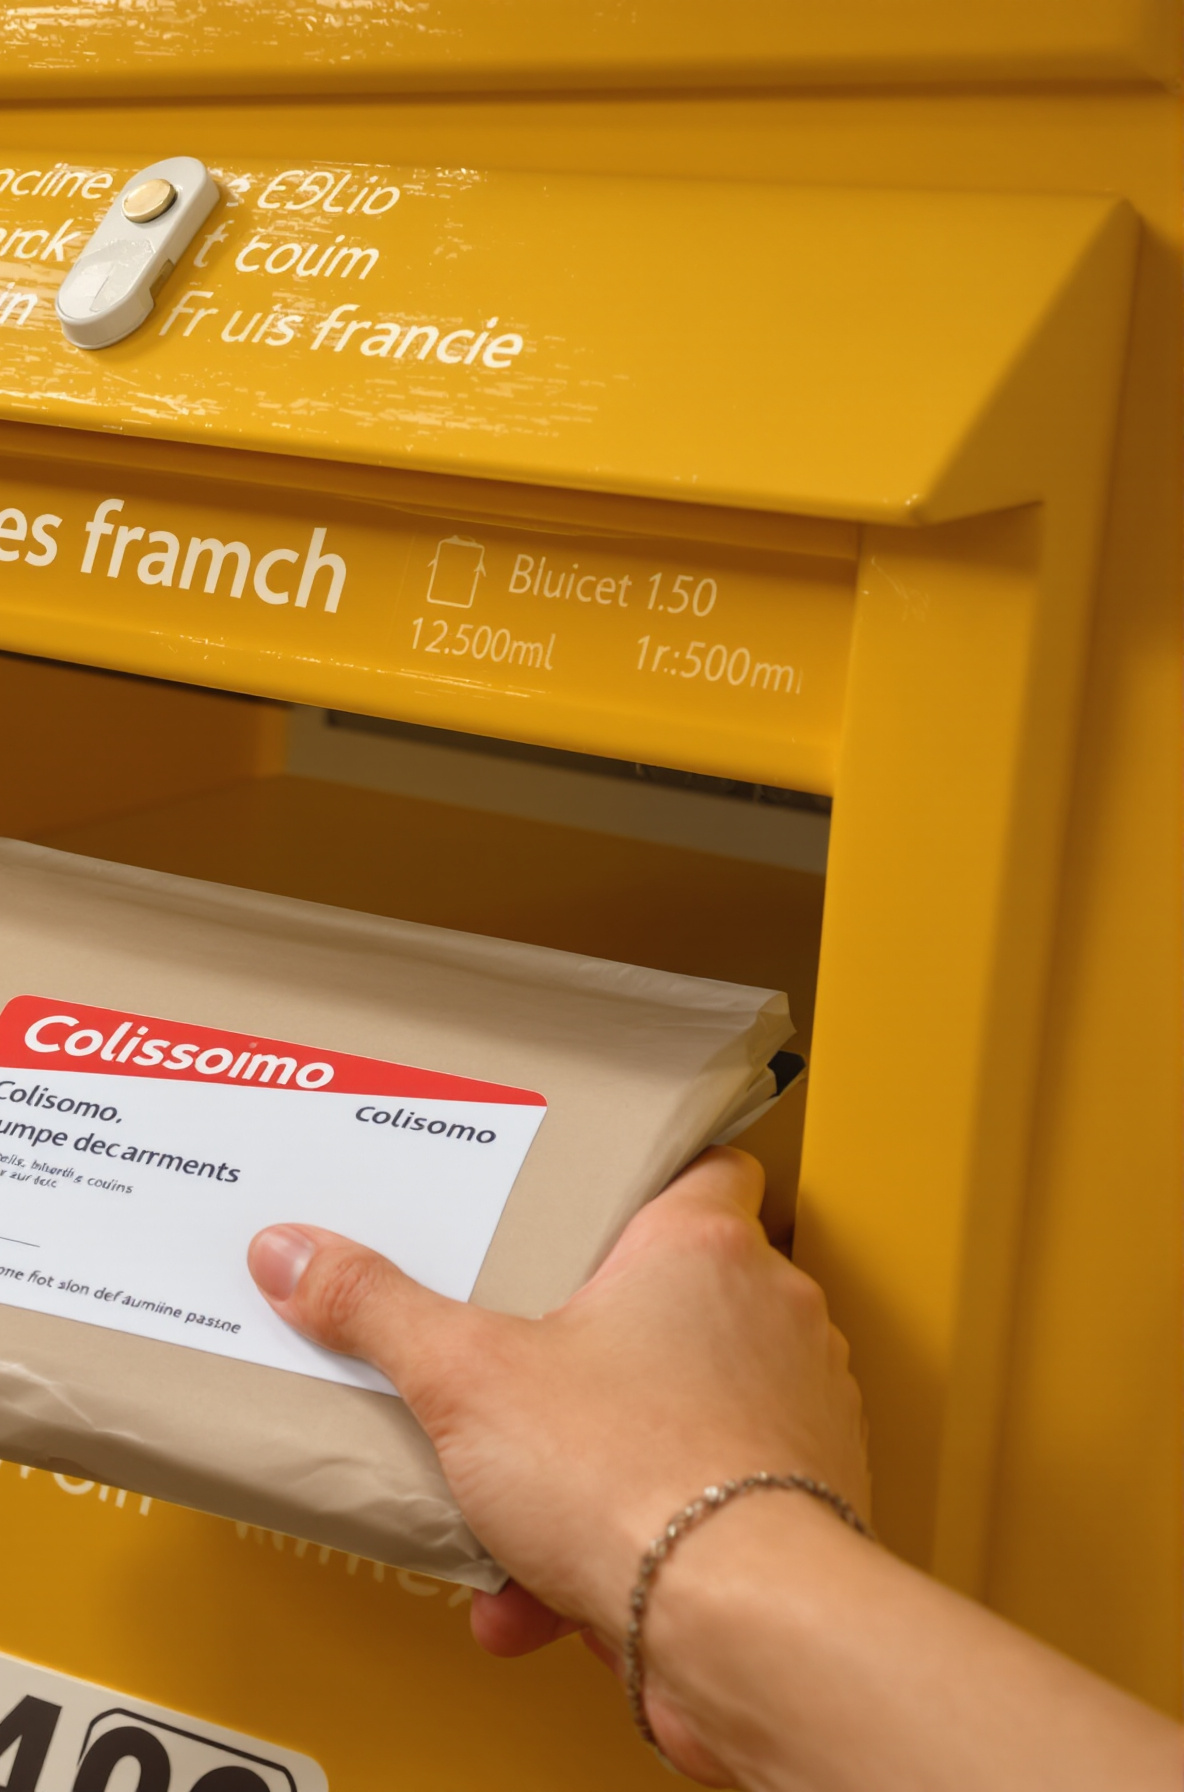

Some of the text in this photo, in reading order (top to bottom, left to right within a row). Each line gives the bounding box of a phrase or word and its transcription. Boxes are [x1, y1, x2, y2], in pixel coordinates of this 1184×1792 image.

[80, 498, 348, 614] framch
[508, 554, 718, 617] Bluicet 1.50
[355, 1105, 498, 1145] Colisomo
